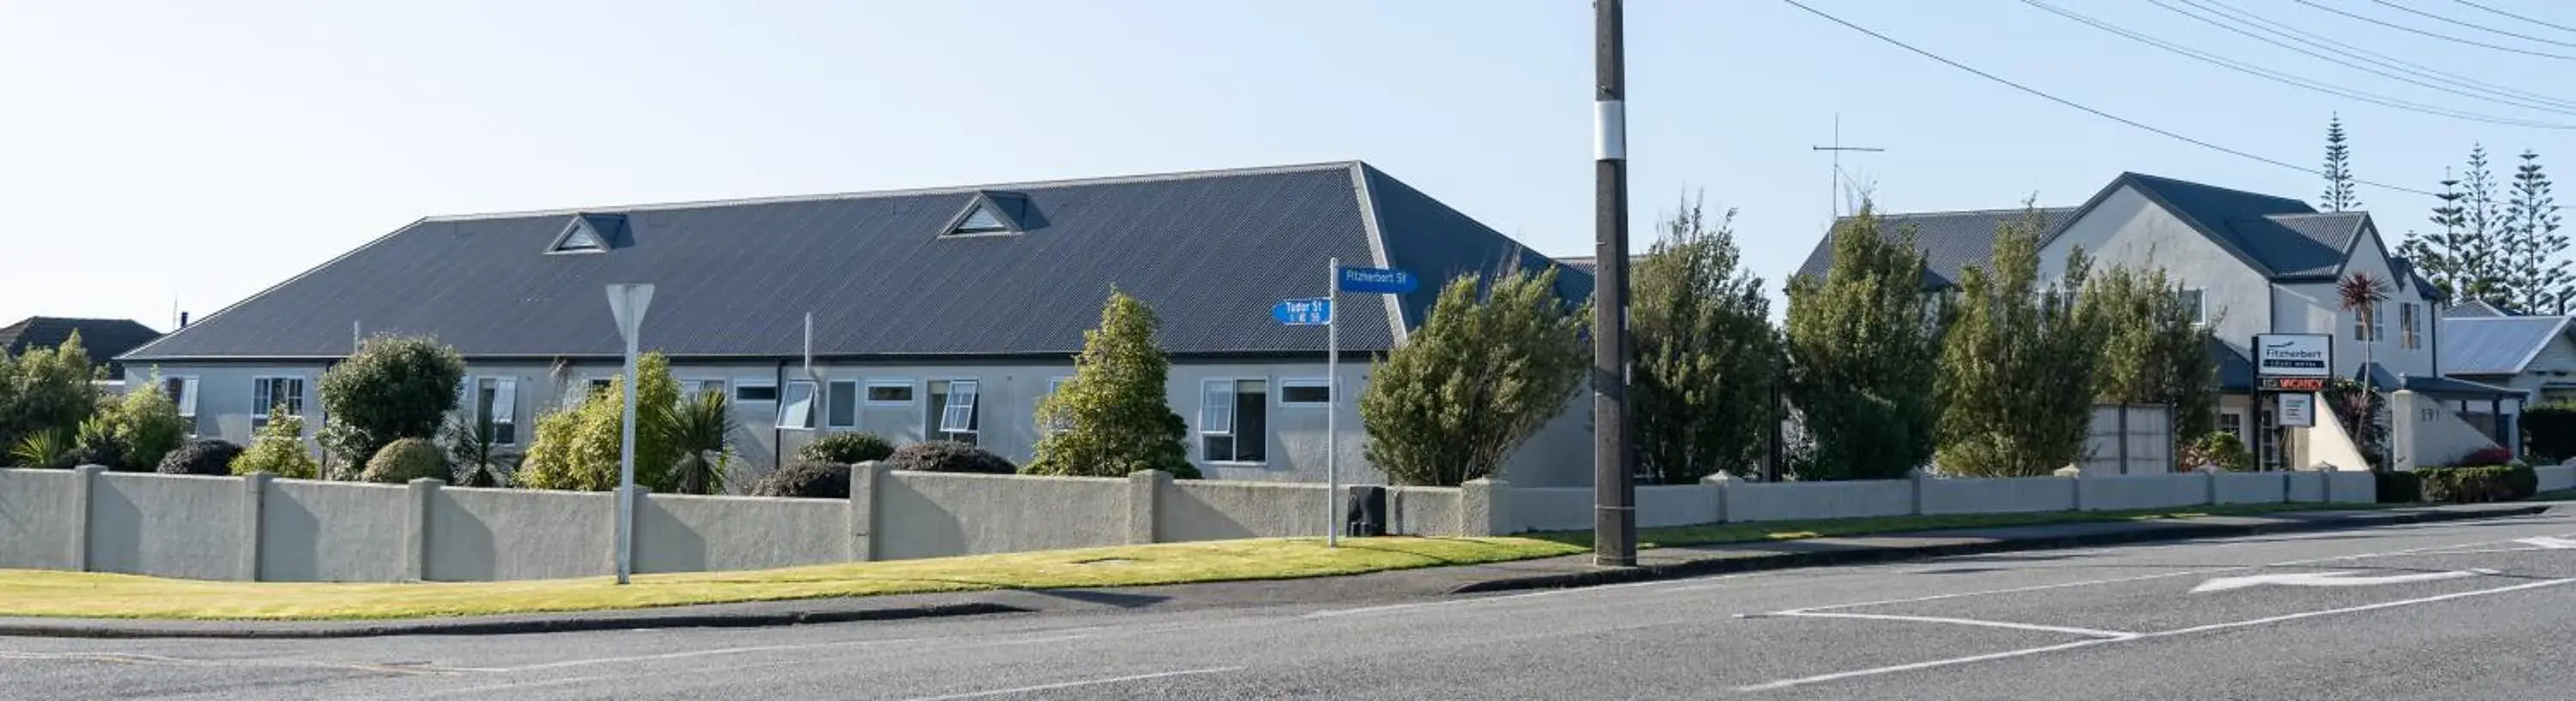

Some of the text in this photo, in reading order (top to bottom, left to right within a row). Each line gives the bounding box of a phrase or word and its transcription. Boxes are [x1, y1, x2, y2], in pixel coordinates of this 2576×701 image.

[1346, 269, 1406, 284] Fitzherbert St
[1310, 300, 1321, 311] St
[2267, 349, 2321, 358] Fitzherbert
[2280, 379, 2323, 387] VACANCY
